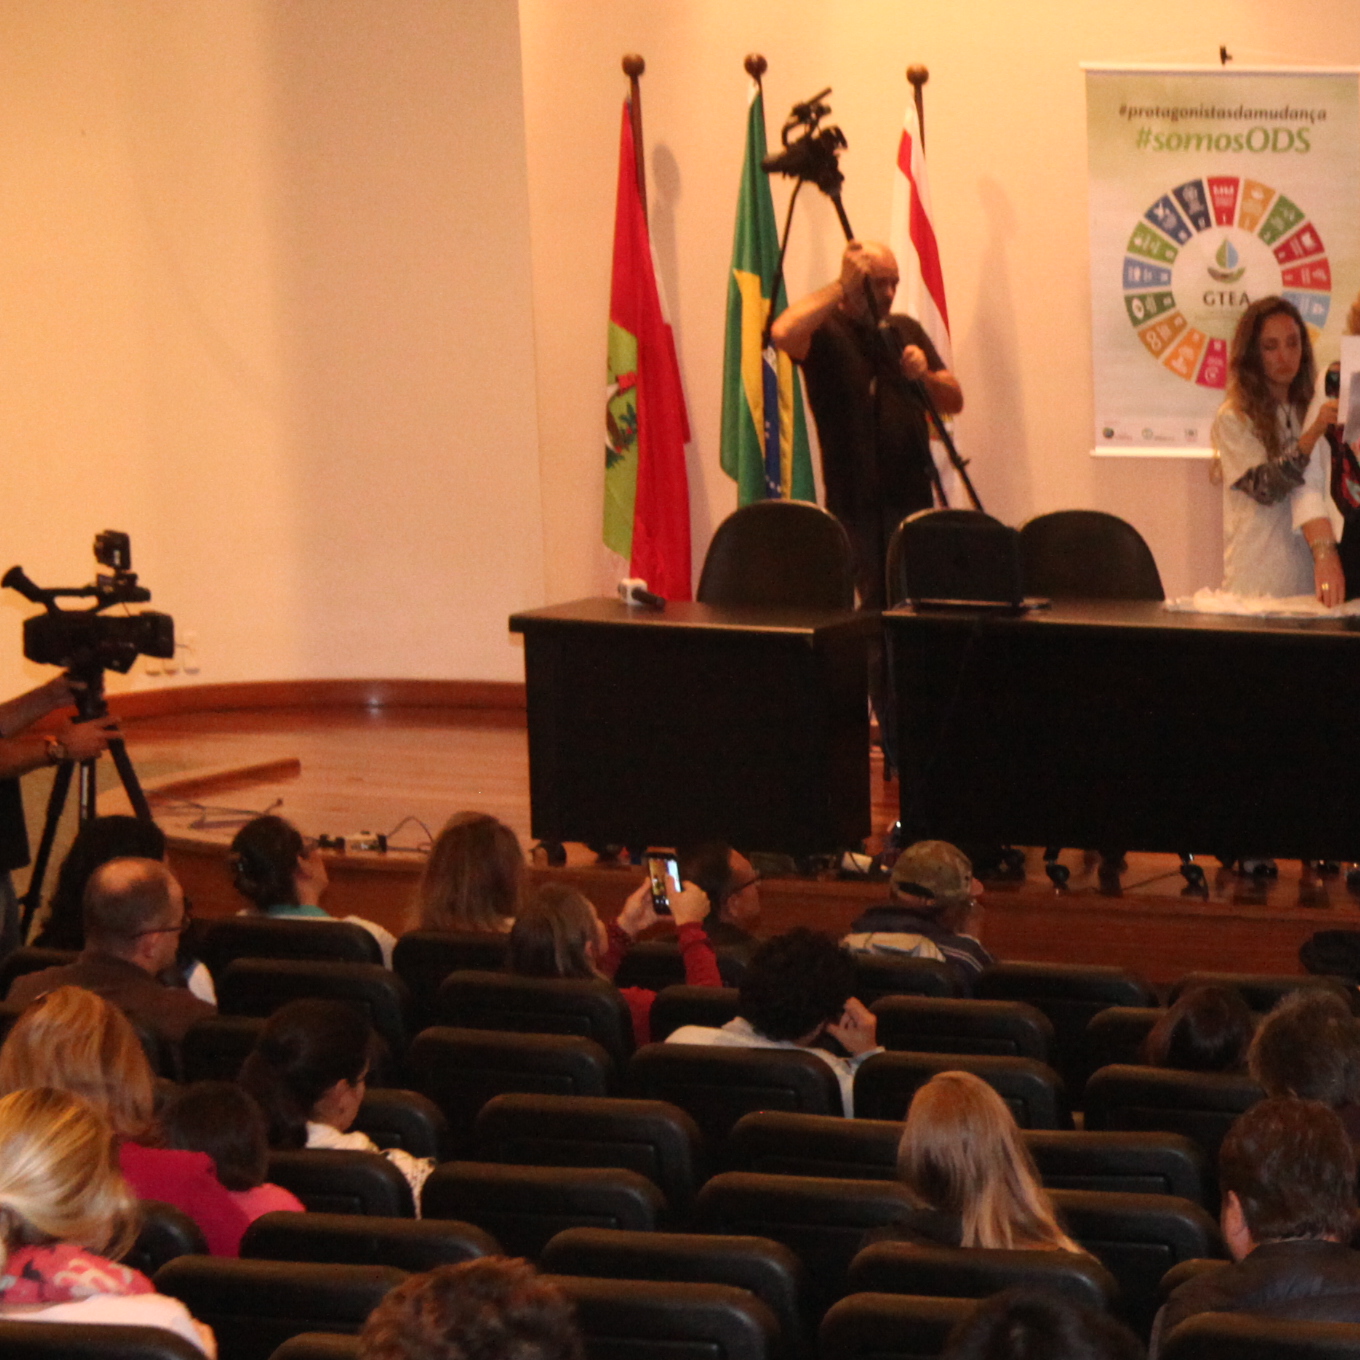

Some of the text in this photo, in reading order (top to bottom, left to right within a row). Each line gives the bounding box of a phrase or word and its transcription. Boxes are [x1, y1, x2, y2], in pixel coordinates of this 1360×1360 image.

[1119, 104, 1327, 124] #protagonistasdamudança
[1136, 126, 1311, 153] #somosODS
[1203, 291, 1250, 307] GTEA
